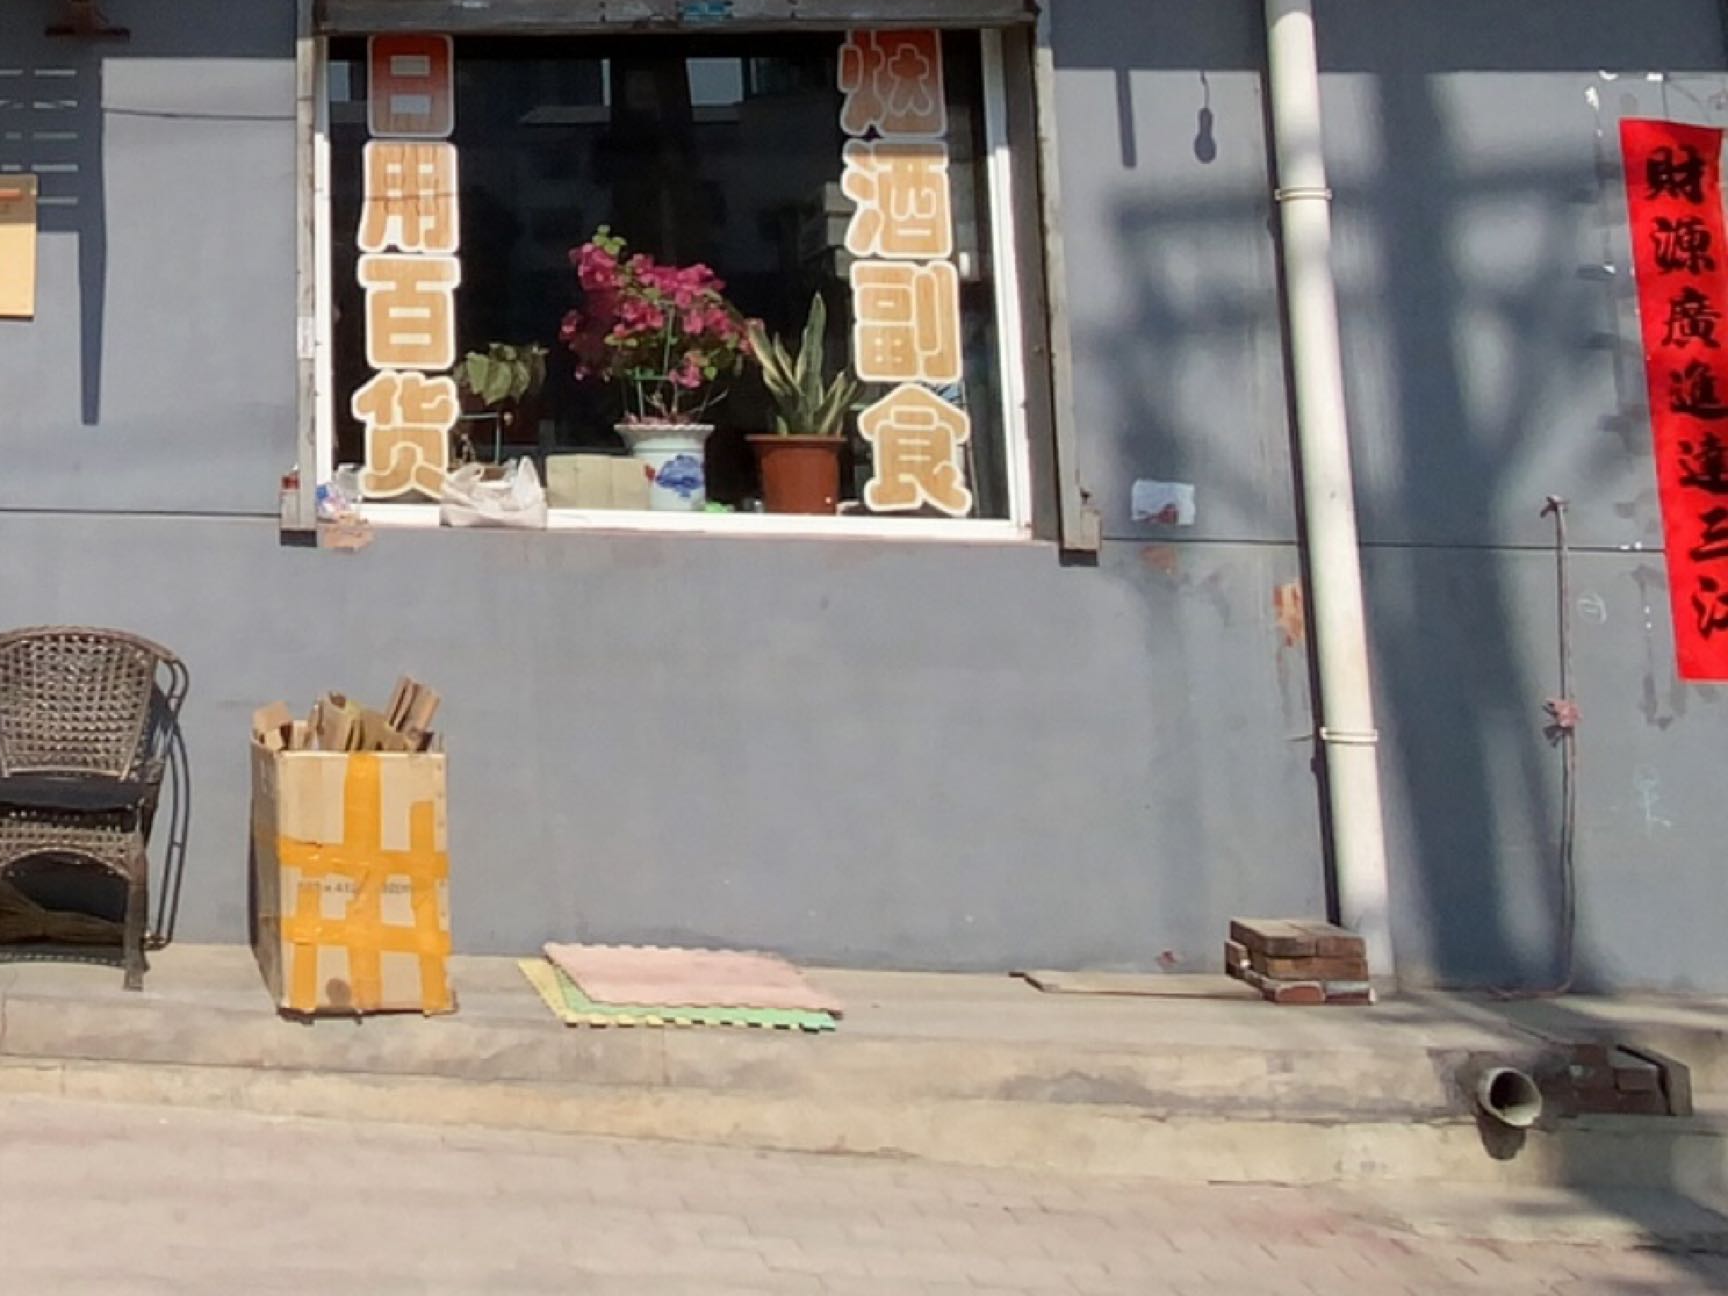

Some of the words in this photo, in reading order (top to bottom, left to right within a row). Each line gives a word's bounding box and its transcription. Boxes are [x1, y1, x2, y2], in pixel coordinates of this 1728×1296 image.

[352, 34, 462, 502] 日用百货
[837, 29, 974, 518] 烟酒副食
